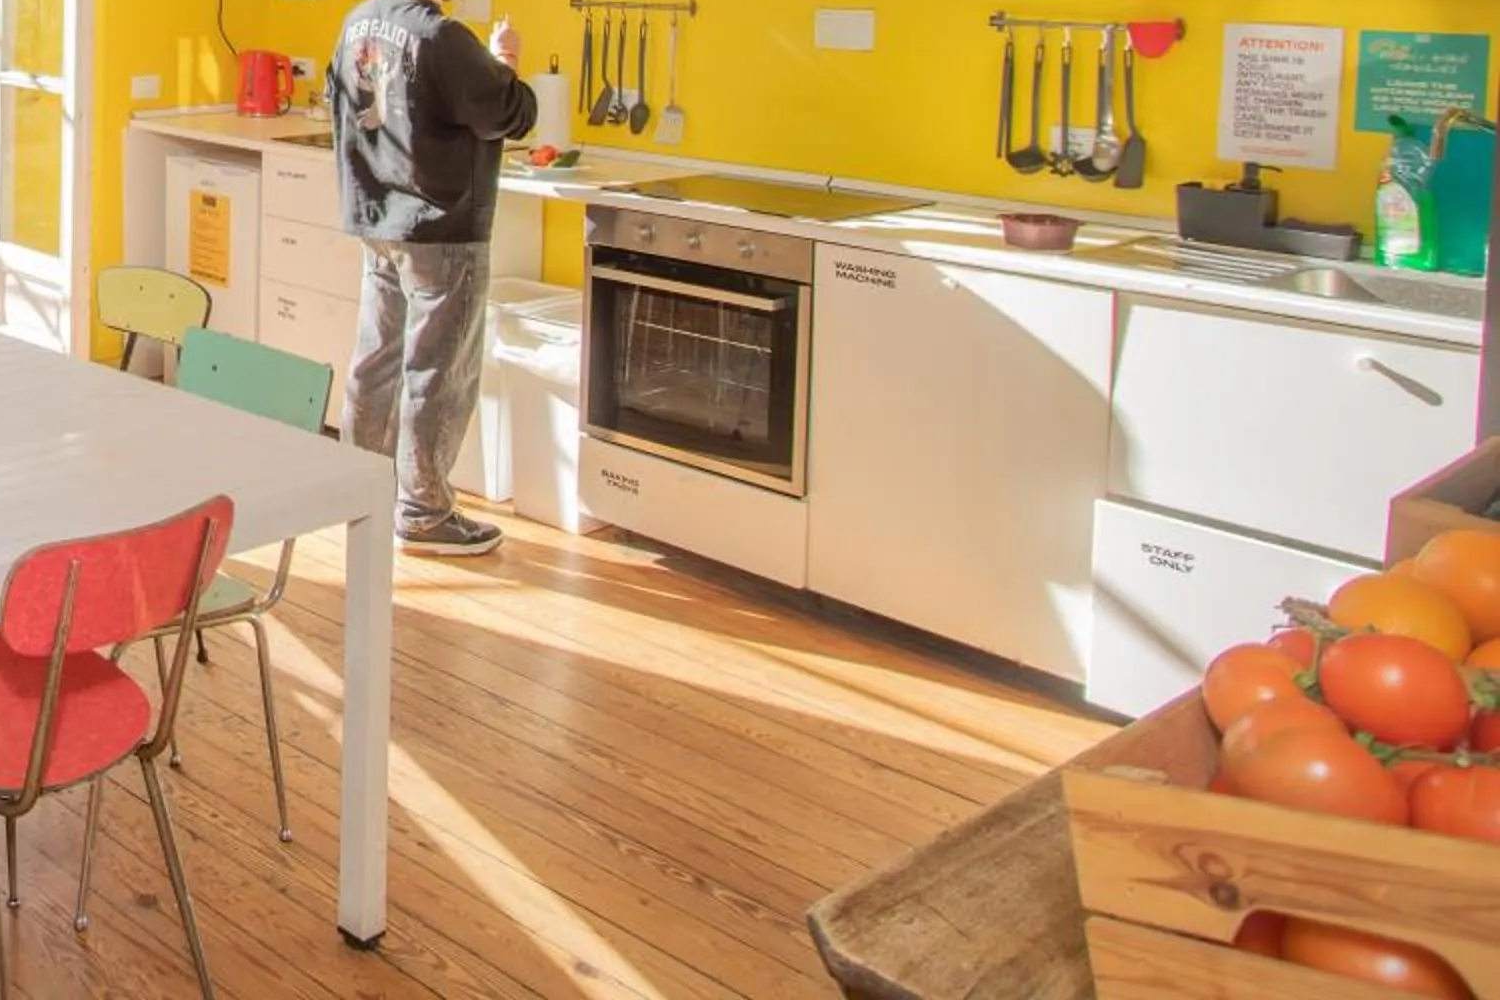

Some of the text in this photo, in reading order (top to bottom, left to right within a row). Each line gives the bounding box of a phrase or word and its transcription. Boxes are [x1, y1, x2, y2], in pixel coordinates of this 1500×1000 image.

[1239, 37, 1325, 52] ATTENTION!
[1237, 53, 1259, 62] THE
[835, 260, 897, 279] WASHING
[835, 270, 897, 289] MACHINE
[601, 468, 640, 487] BAKING
[1141, 543, 1195, 561] STAFF
[1149, 555, 1195, 573] ONLY
